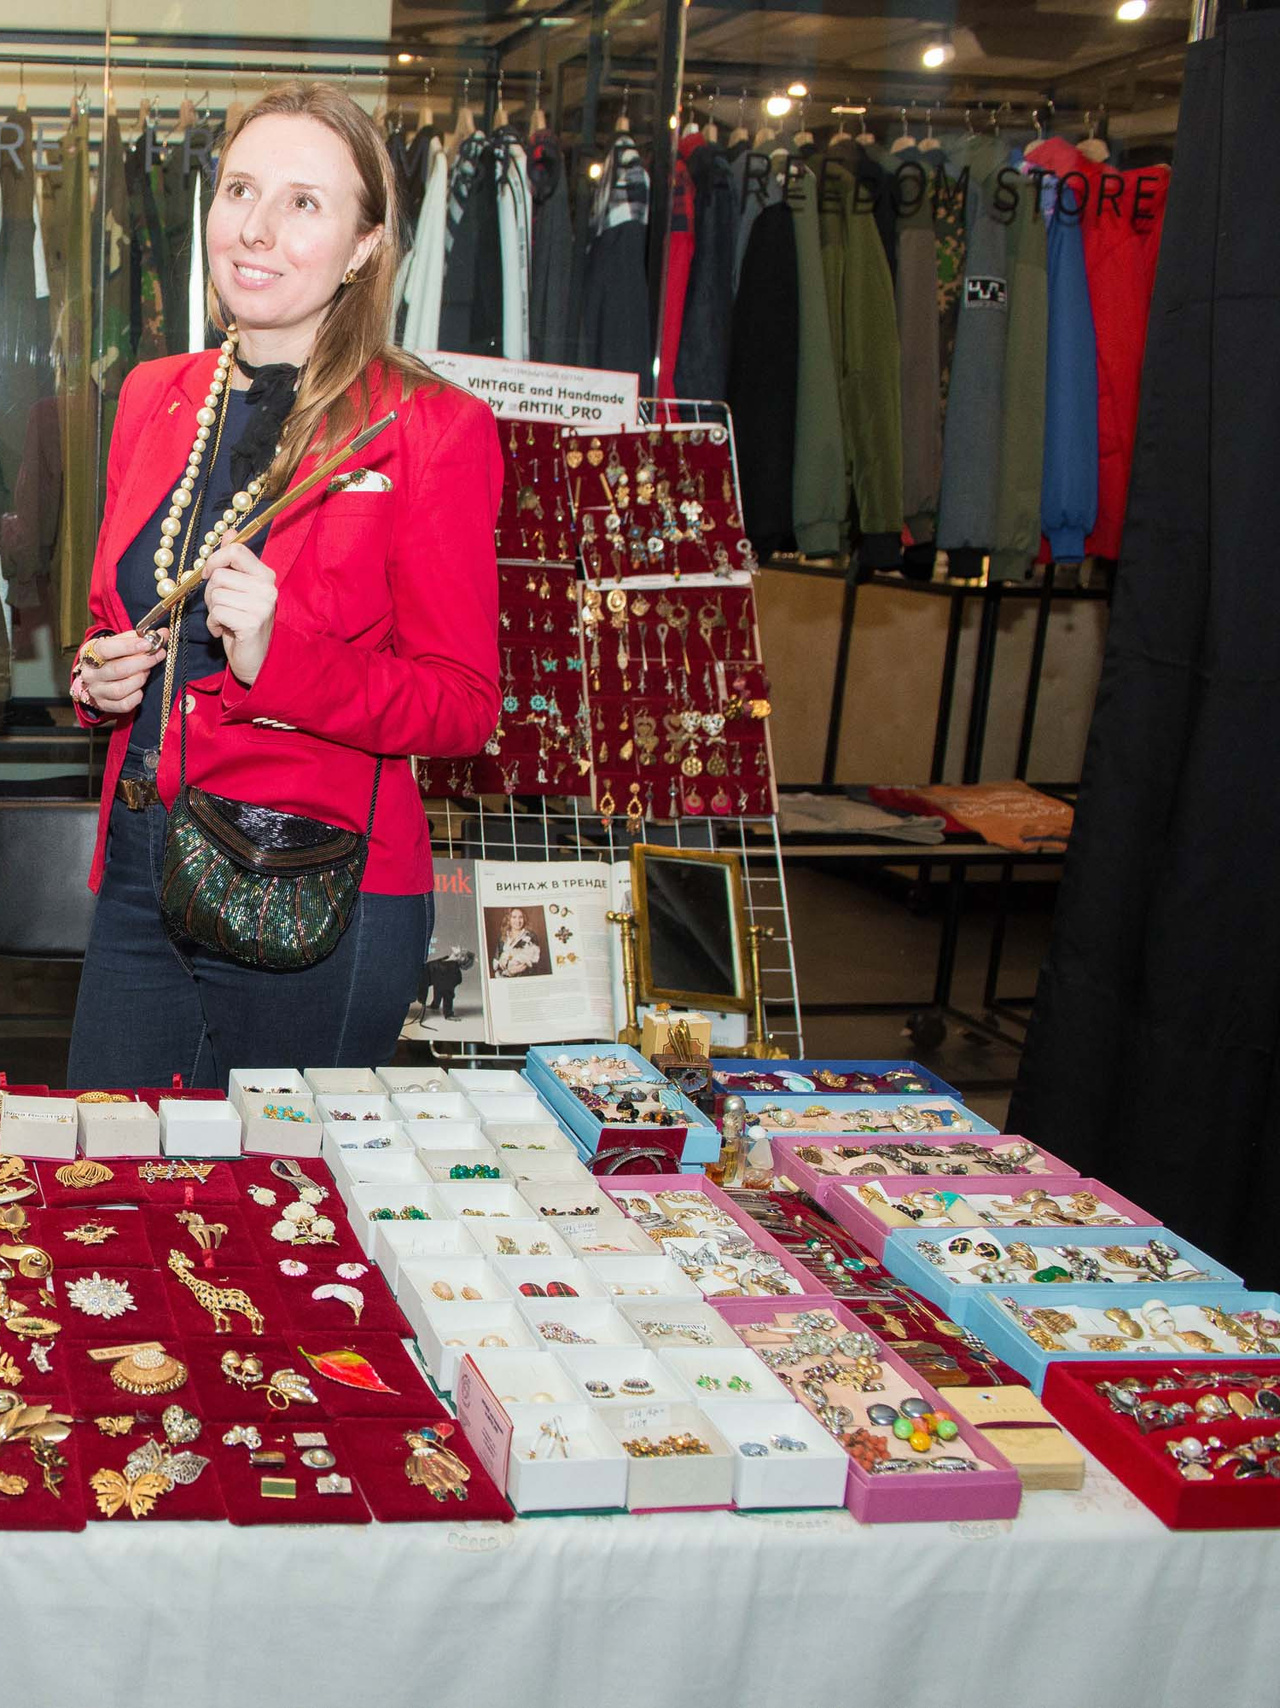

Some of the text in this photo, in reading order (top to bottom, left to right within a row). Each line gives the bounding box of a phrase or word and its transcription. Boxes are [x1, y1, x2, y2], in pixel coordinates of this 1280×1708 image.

[993, 166, 1160, 220] STORE
[467, 376, 625, 405] VINTAGE and Handmade
[487, 396, 504, 412] by
[495, 881, 549, 892] ВИНТАЖ
[551, 880, 559, 889] В
[562, 878, 609, 889] ТРЕНДЕ
